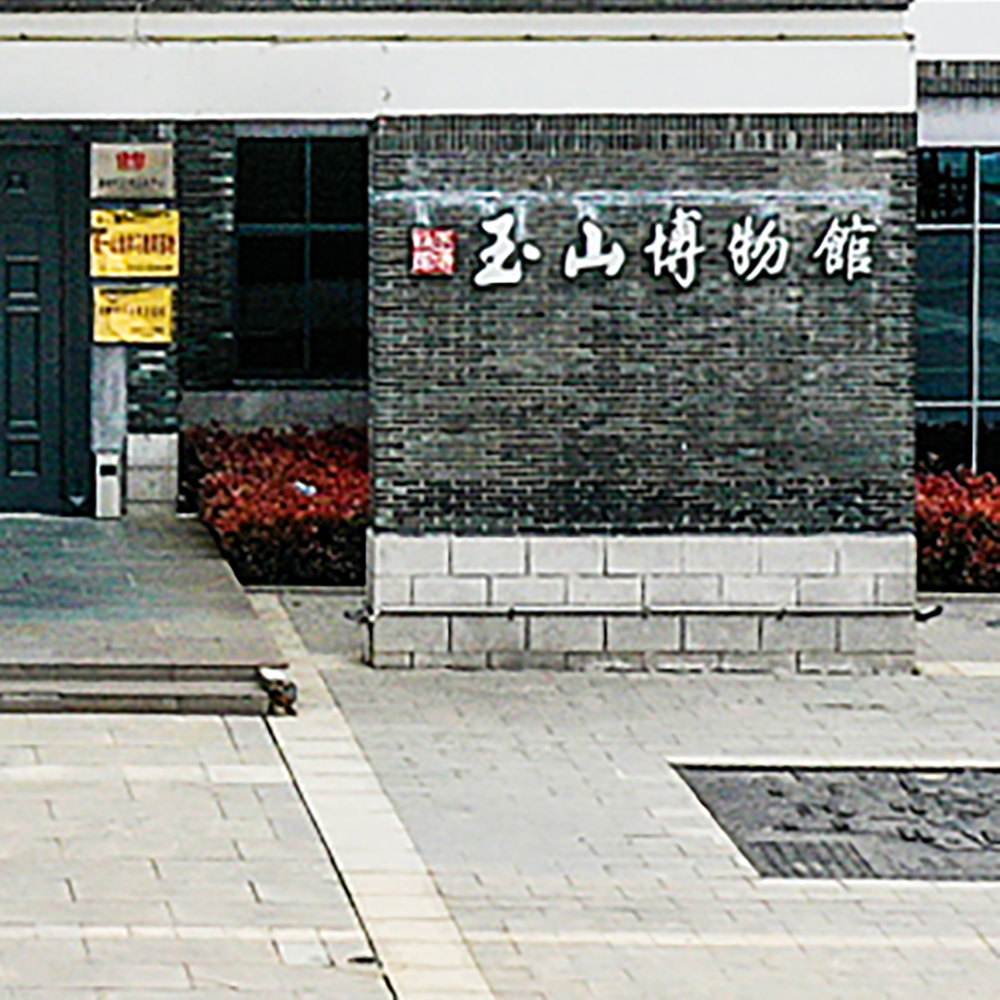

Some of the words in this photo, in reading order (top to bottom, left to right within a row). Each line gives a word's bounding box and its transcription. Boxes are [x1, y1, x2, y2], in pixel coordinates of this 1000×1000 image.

[473, 206, 880, 289] 玉山博物館
